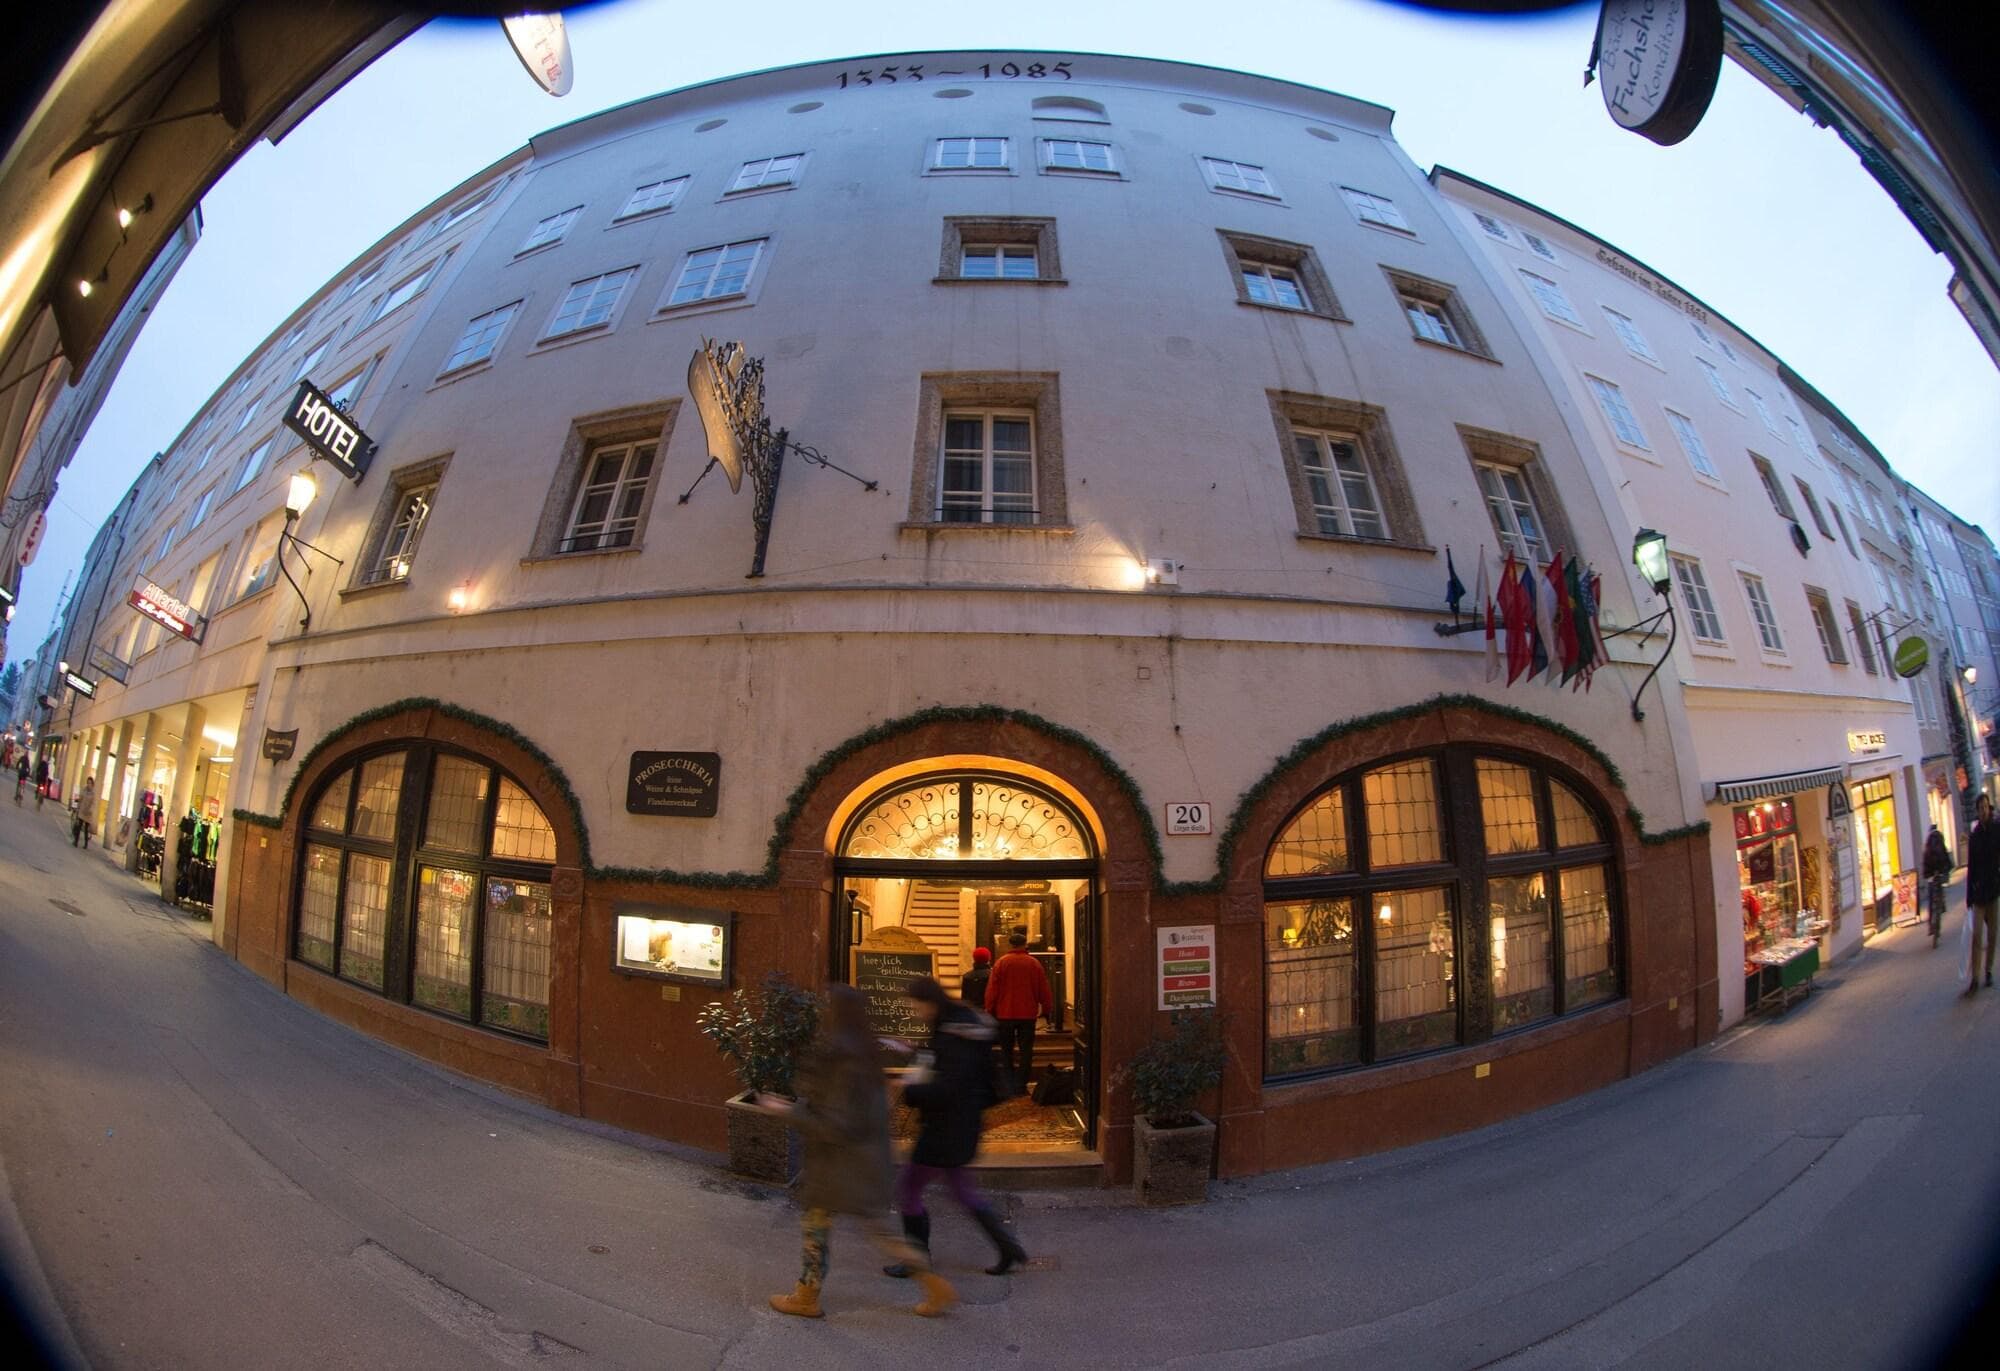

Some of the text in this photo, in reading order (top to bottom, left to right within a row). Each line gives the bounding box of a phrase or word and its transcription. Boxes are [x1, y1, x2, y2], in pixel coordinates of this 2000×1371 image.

[834, 64, 925, 90] 1353
[978, 61, 1074, 82] 1985
[295, 391, 360, 468] HOTEL
[634, 758, 714, 787] PROSECCHERIA
[1176, 805, 1202, 824] 20
